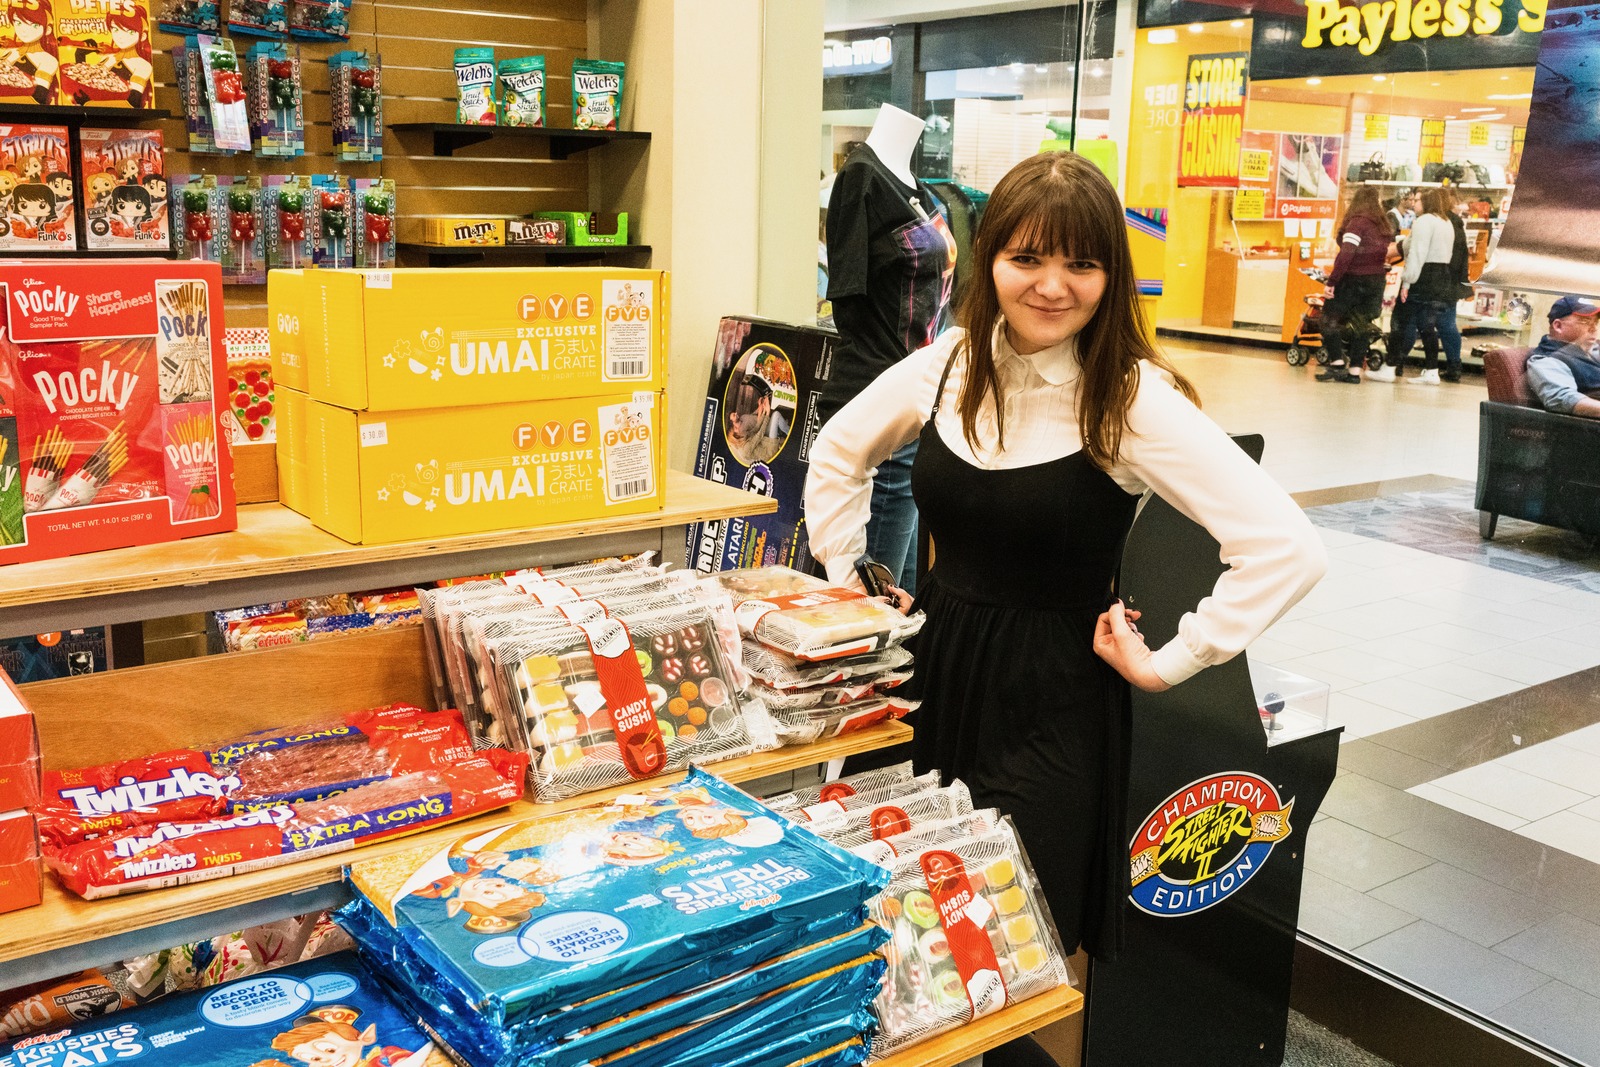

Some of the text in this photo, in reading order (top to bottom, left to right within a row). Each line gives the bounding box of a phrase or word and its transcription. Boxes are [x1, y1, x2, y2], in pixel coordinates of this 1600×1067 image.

[59, 22, 108, 35] CRUNCH!
[1302, 0, 1503, 55] Payless
[292, 59, 301, 96] GUMMI
[373, 67, 382, 102] GUMMI
[457, 65, 493, 82] Welch's
[578, 75, 619, 90] Welch's
[1187, 58, 1246, 108] STORE
[188, 51, 197, 120] GINORMOUS
[259, 57, 268, 124] GINORMOUS
[465, 92, 481, 100] Fruit
[342, 65, 350, 130] GINORMOUS
[462, 98, 484, 108] Snacks
[592, 99, 608, 107] Fruit
[587, 105, 612, 114] Snacks
[1181, 113, 1242, 178] CLOSING
[210, 190, 219, 225] GUMMI
[1290, 204, 1312, 214] Payless
[175, 190, 184, 255] GINORMOUS
[220, 191, 228, 255] GINORMOUS
[86, 290, 122, 306] Share
[89, 292, 154, 318] Happiness!
[522, 297, 589, 319] FYE
[608, 307, 647, 319] FYE
[160, 310, 207, 341] POCK
[517, 325, 596, 338] EXCLUSIVE
[450, 339, 549, 376] UMAI
[554, 339, 596, 355] うまい
[554, 355, 596, 370] CRATE
[59, 413, 81, 421] COVERED
[704, 404, 713, 442] ASSEMBLE
[518, 422, 587, 447] FYE
[607, 427, 647, 444] FYE
[801, 420, 813, 457] ADJUSTABLE
[511, 450, 593, 466] EXCLUSIVE
[702, 442, 707, 452] TO
[550, 463, 593, 481] うまい
[445, 466, 545, 505] UMAI
[550, 478, 593, 495] CRATE
[48, 523, 71, 532] TOTAL
[72, 521, 87, 529] NET
[88, 519, 100, 527] WT.
[102, 517, 120, 525] 14.01
[130, 513, 145, 521] (397
[145, 512, 153, 520] g)
[727, 517, 744, 564] ATARI
[741, 521, 750, 553] INCLUDED
[714, 543, 723, 572] HOME
[258, 634, 292, 647] efrutti
[613, 698, 648, 721] CANDY
[618, 710, 652, 732] SUSHI
[402, 725, 451, 740] strawberry
[212, 738, 282, 765] EXTRA
[286, 726, 350, 743] LONG
[1147, 780, 1267, 842] CHAMPION
[82, 816, 123, 831] TWISTS
[291, 797, 445, 850] EXTRA LONG
[1157, 800, 1226, 866] STREET
[1170, 804, 1253, 864] FIGHTER
[123, 853, 197, 880] Twizzlers
[203, 851, 242, 866] TWISTS
[654, 847, 744, 874] Treat Sheet
[1189, 847, 1222, 886] II
[661, 858, 794, 900] TREATS
[771, 868, 811, 889] RICE
[1151, 855, 1254, 909] EDITION
[676, 881, 772, 915] KRISPIES
[739, 893, 781, 911] Kellogg's
[940, 889, 971, 916] SUSHI
[470, 917, 508, 928] POP
[549, 930, 587, 947] SERVE
[552, 928, 620, 953] DECORATE
[561, 935, 625, 958] READY TO
[56, 991, 90, 1003] WORLD
[210, 980, 279, 1003] READY TO
[211, 985, 283, 1010] DECORATE
[244, 991, 288, 1008] SERVE
[234, 1008, 263, 1020] decorate
[319, 1010, 356, 1023] POP
[13, 1029, 71, 1051] Kellogg's
[17, 1024, 138, 1064] KRISPIES
[149, 1030, 175, 1041] CRISPY
[151, 1026, 205, 1045] MARSHMALLOW
[153, 1036, 187, 1048] SQUARES
